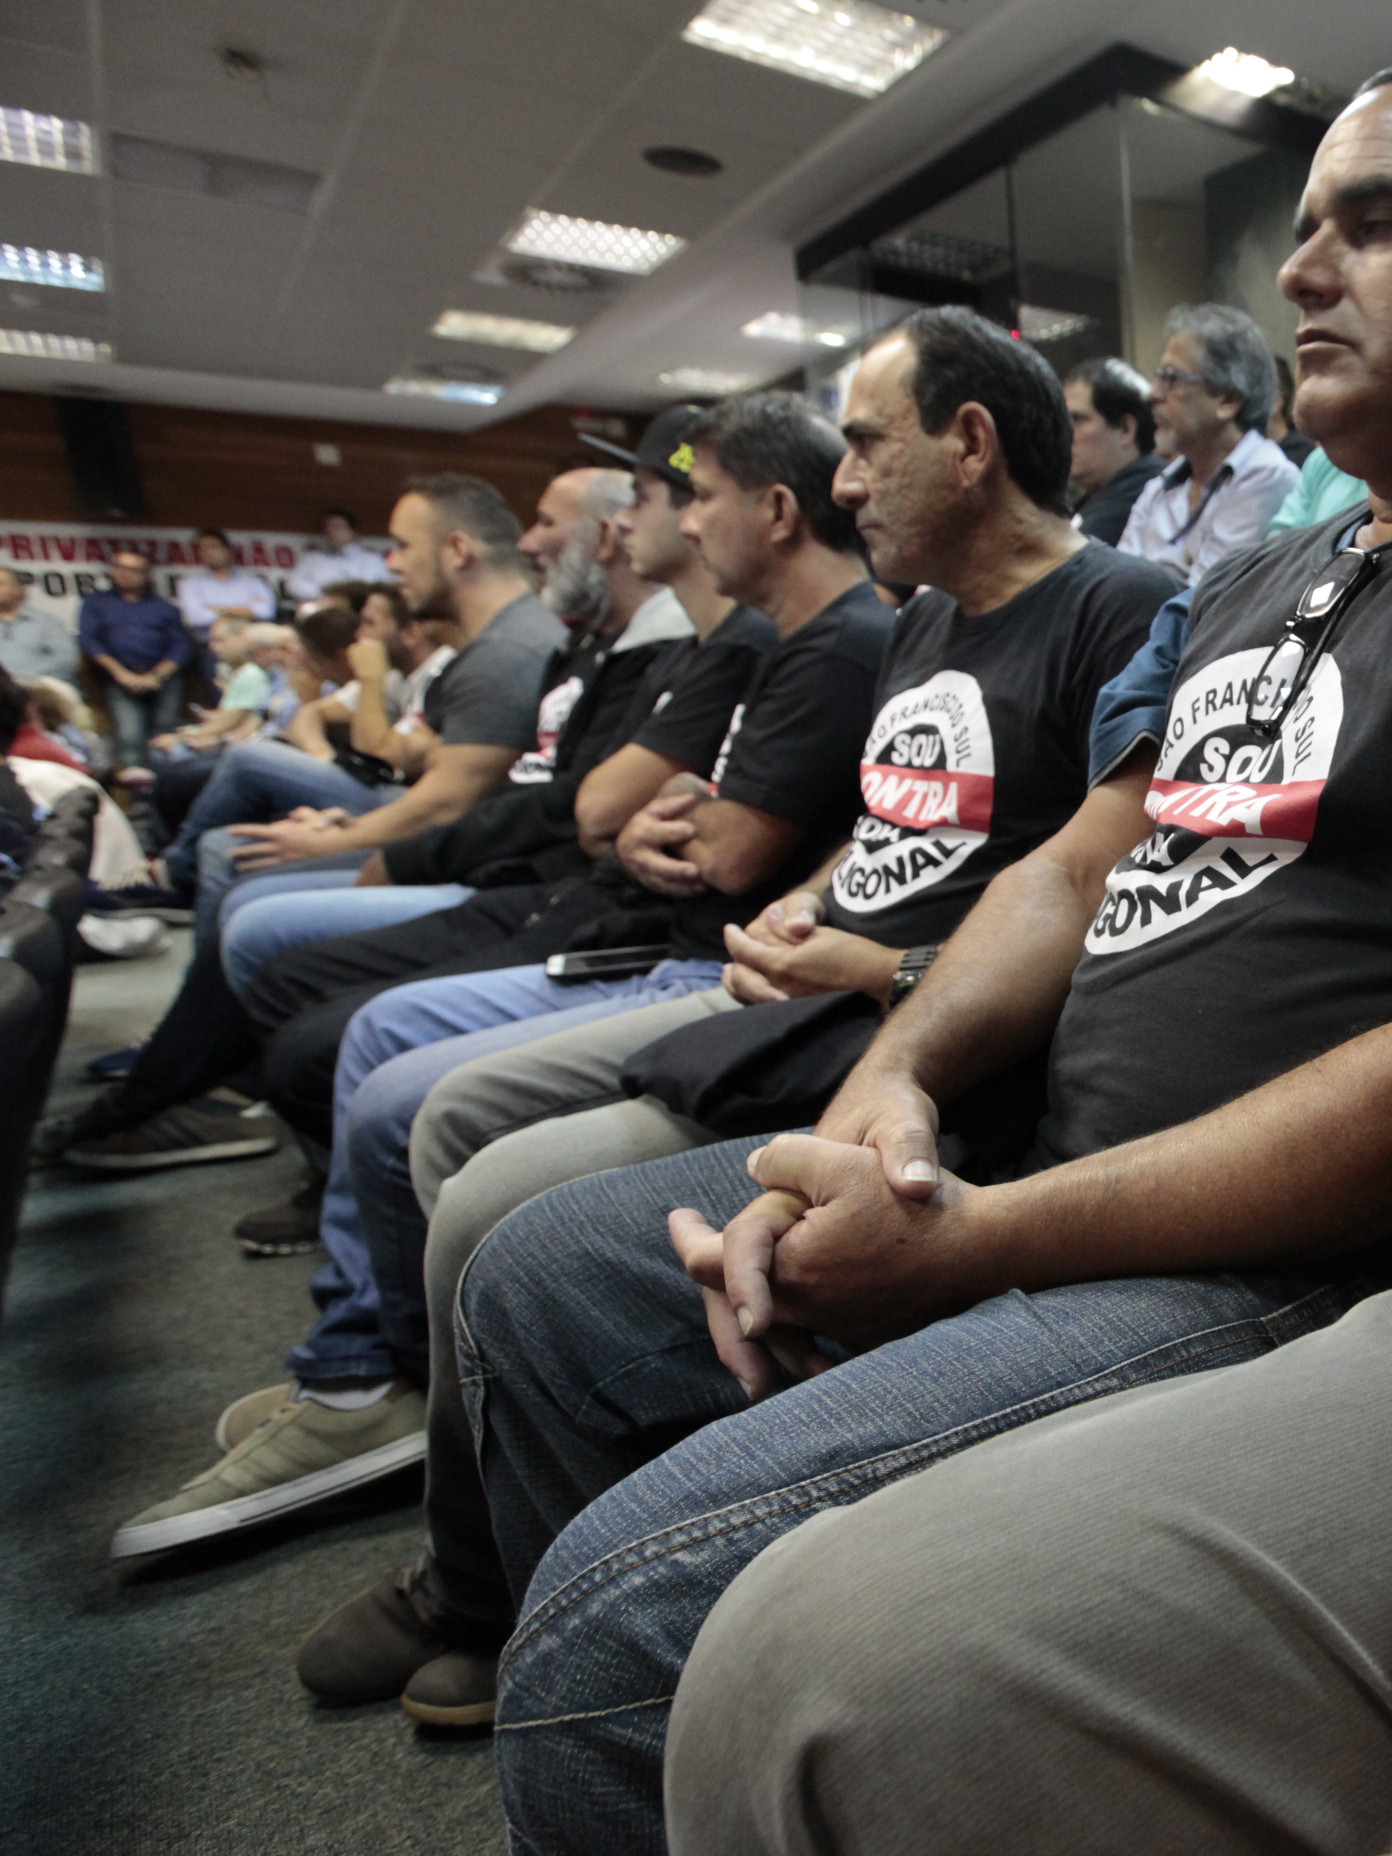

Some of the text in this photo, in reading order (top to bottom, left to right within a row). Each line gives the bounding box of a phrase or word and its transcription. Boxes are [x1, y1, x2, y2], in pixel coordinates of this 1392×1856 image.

[890, 732, 941, 768] SOU
[1200, 736, 1283, 783] SOU
[861, 771, 960, 824] ONTRA
[1093, 846, 1280, 939] GONAL
